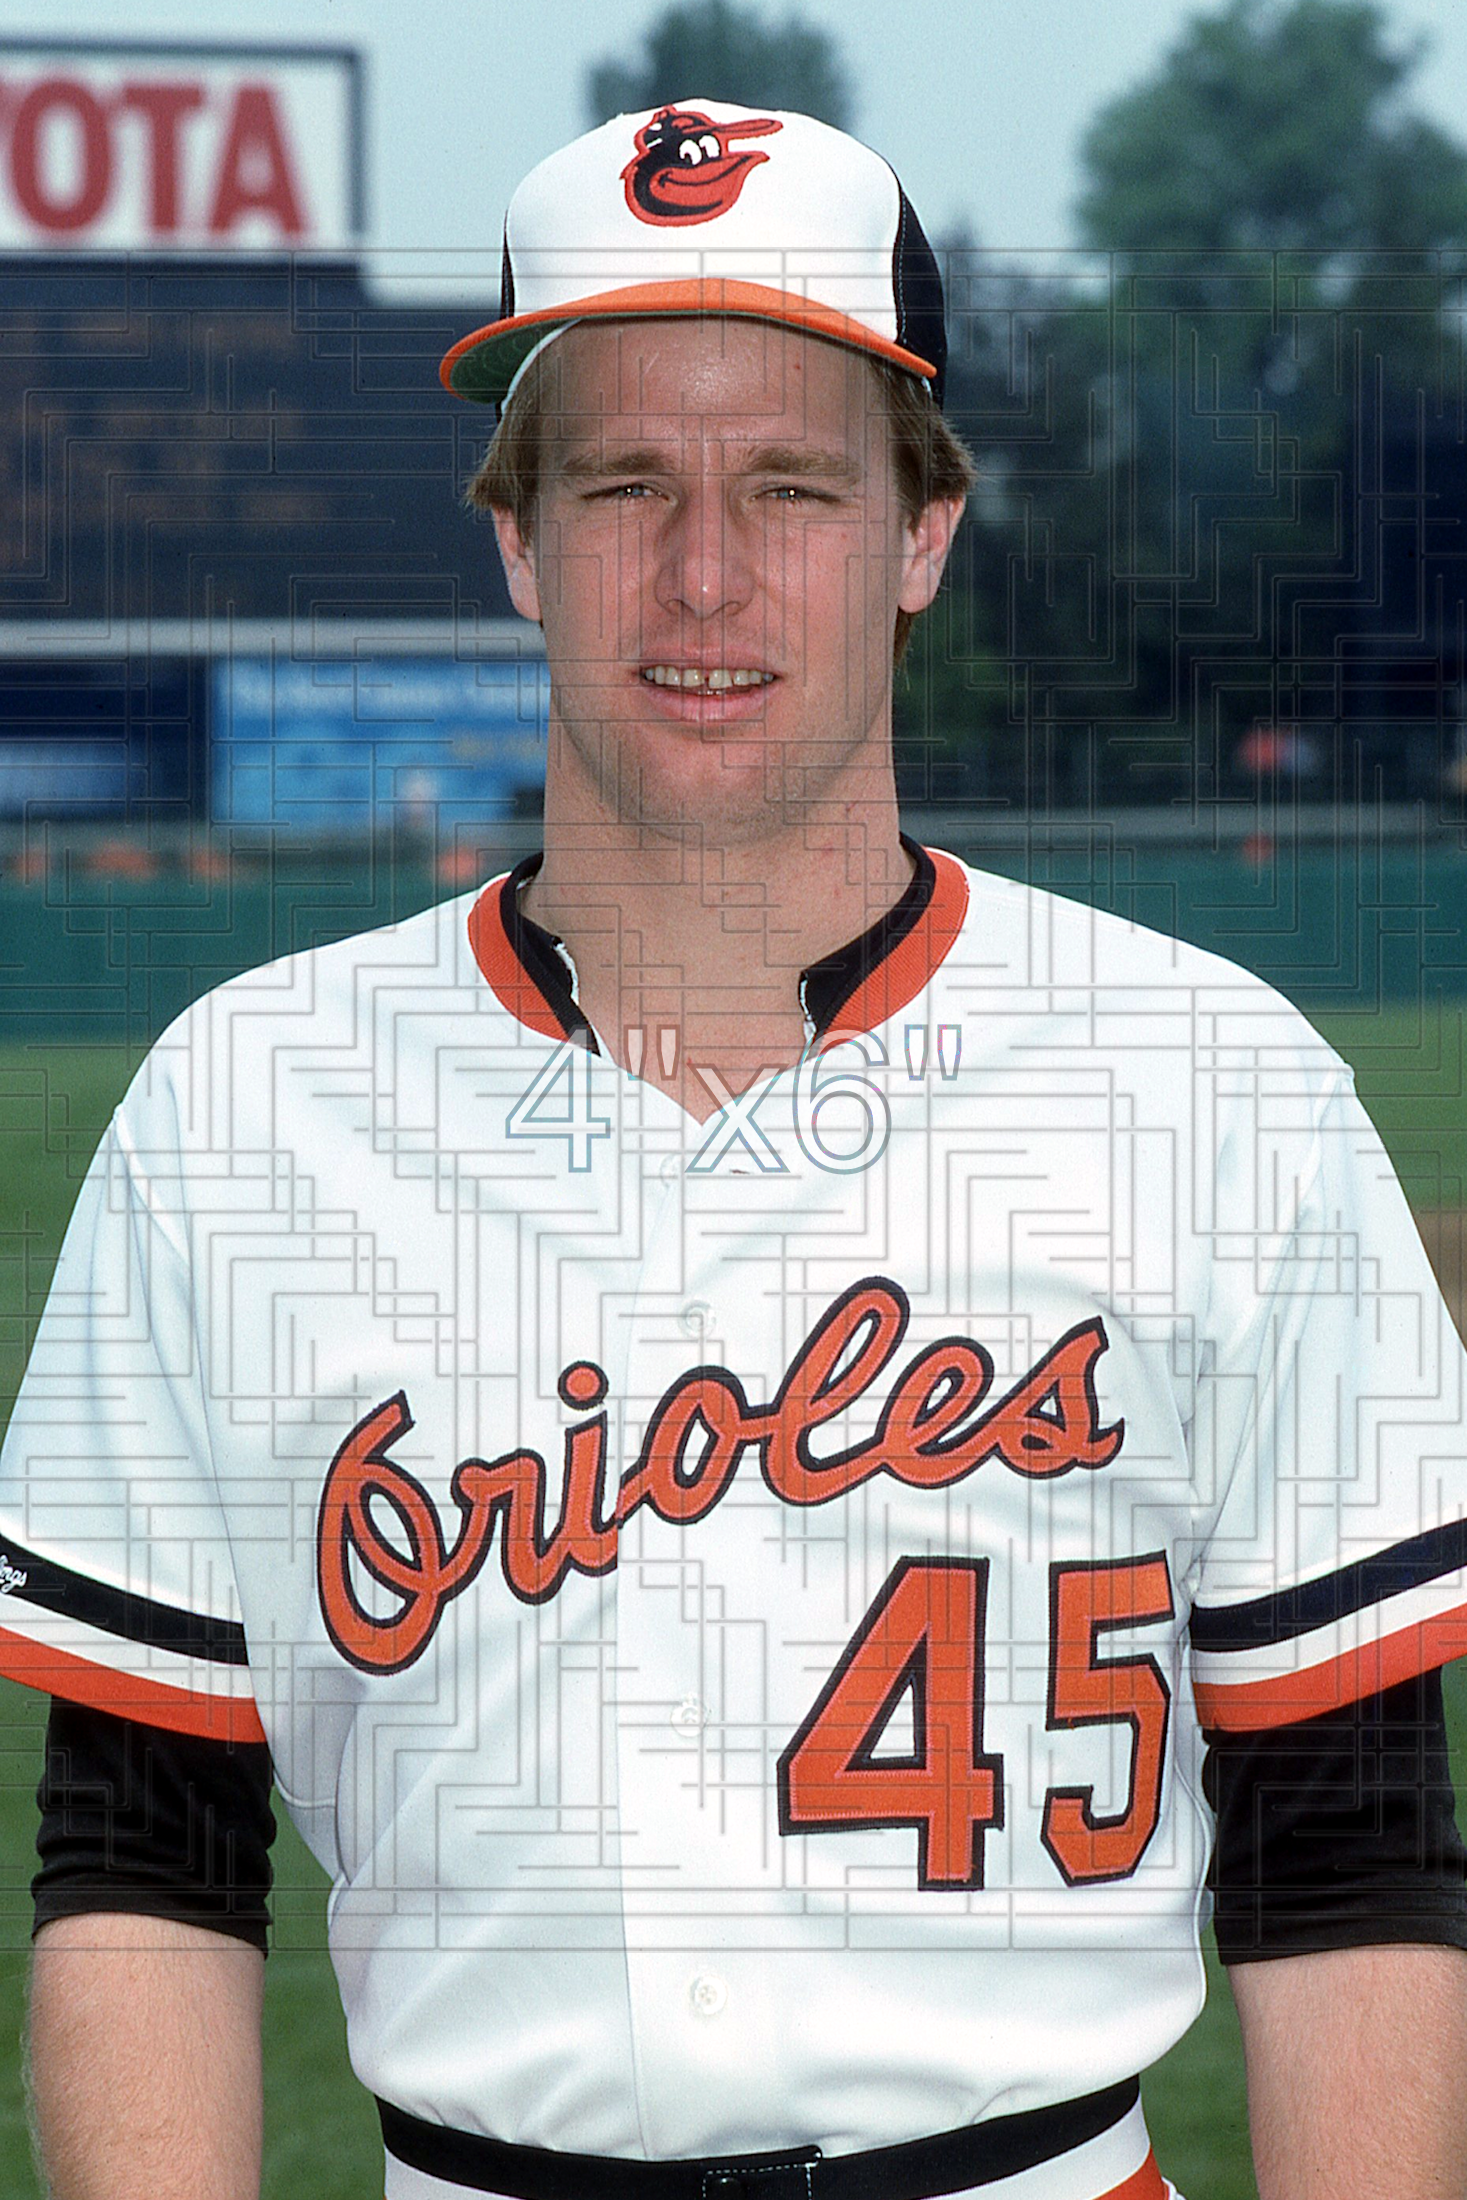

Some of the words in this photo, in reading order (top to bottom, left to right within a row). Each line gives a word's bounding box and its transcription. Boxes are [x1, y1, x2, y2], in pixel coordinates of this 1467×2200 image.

[0, 79, 309, 234] OTA
[317, 1276, 1125, 1674] Orioles
[777, 1550, 1175, 1892] 45
